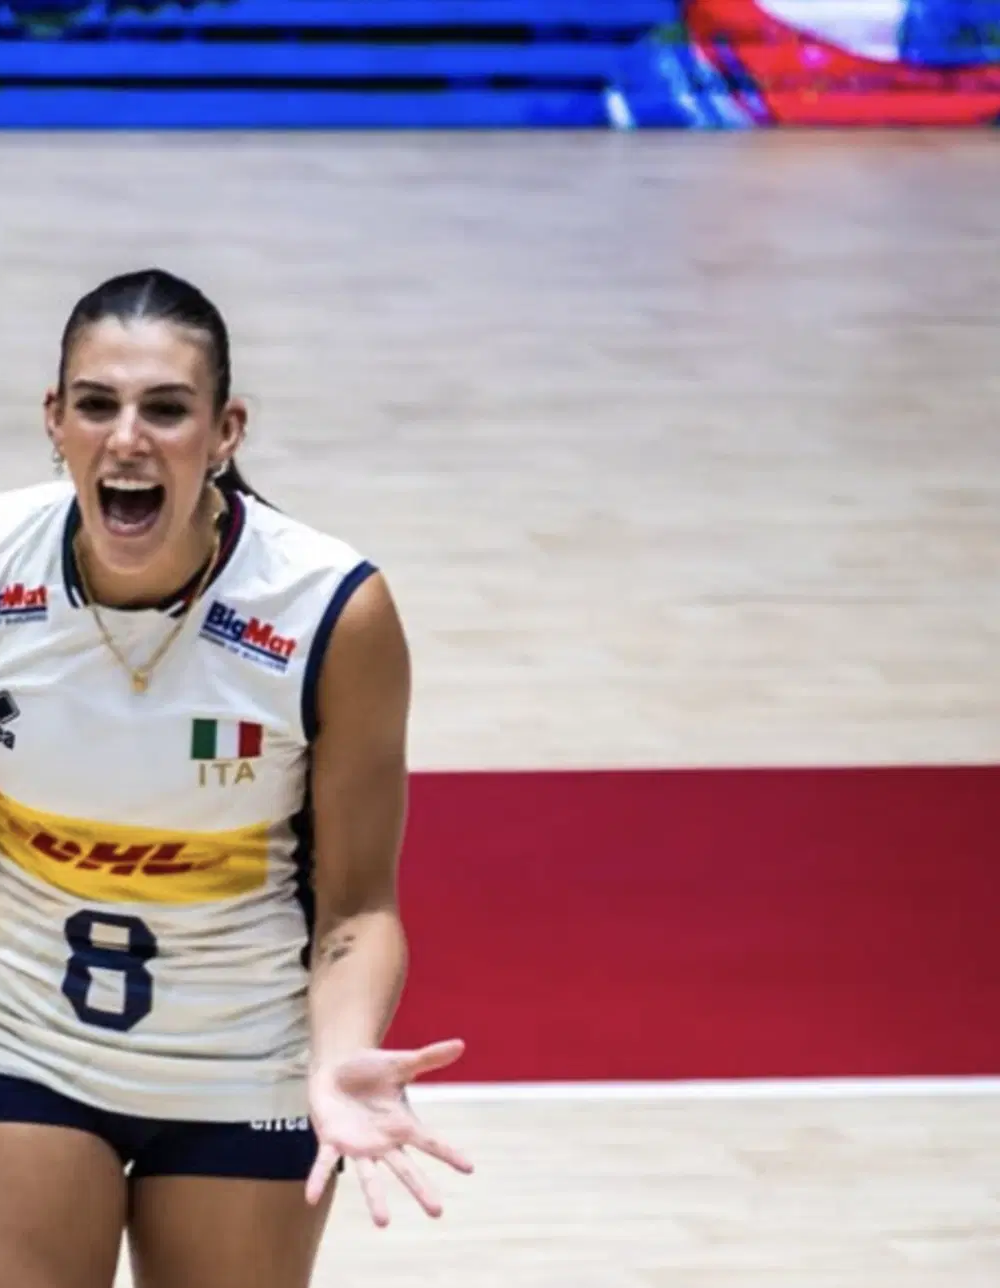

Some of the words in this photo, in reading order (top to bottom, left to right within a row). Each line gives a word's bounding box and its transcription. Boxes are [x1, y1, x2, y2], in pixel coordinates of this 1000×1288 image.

[205, 600, 297, 657] BigMat
[198, 762, 255, 788] ITA
[30, 830, 193, 877] DHL
[61, 908, 158, 1032] 8
